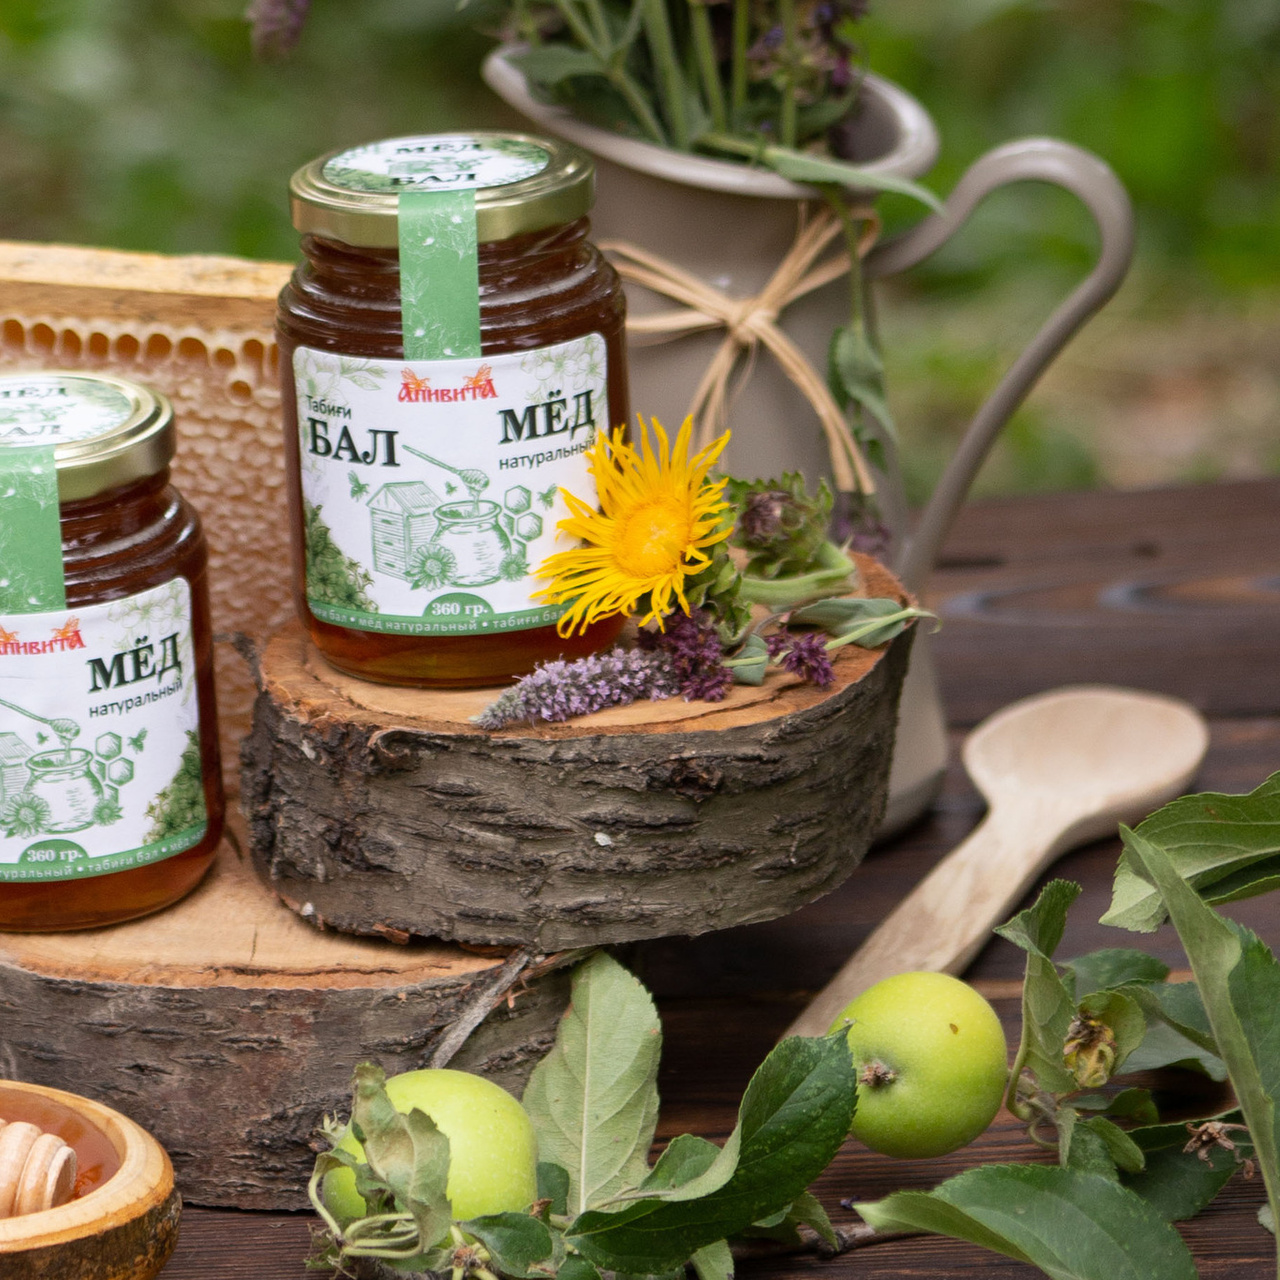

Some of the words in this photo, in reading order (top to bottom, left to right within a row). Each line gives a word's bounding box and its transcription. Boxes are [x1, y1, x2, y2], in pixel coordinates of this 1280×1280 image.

[391, 173, 478, 186] БАЛ
[306, 395, 352, 419] Табиғи
[496, 389, 596, 445] МЁД
[307, 417, 401, 467] БАЛ
[431, 602, 461, 616] 360
[464, 603, 489, 618] гр.
[358, 617, 383, 629] мёд
[386, 620, 478, 633] натуральный
[493, 614, 539, 629] табиғи
[86, 631, 183, 693] МЁД
[89, 677, 184, 718] натуральный
[26, 849, 56, 863] 360
[59, 850, 83, 865] гр.
[88, 856, 134, 872] табиғи
[136, 851, 159, 862] бал
